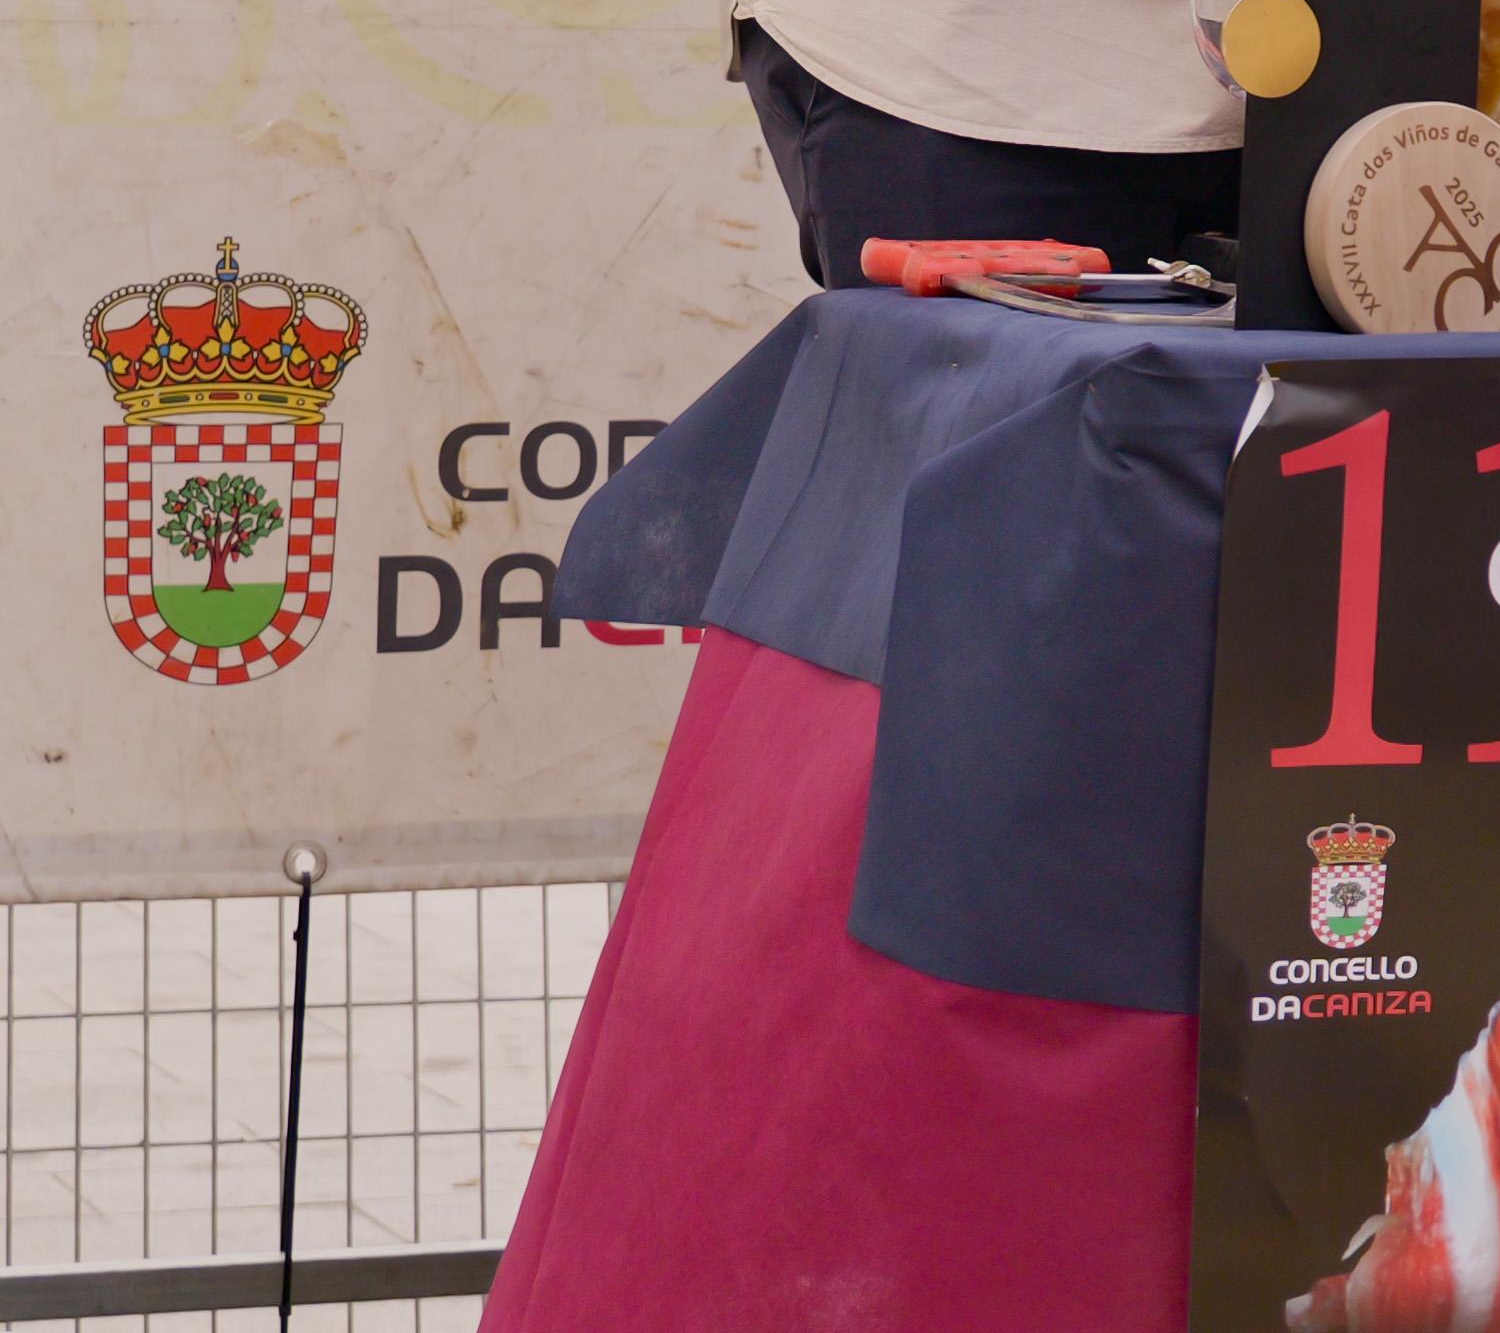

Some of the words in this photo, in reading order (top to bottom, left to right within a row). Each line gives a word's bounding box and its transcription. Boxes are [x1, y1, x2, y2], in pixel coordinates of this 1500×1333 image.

[1394, 125, 1450, 149] Viños
[1456, 126, 1479, 147] de
[1364, 147, 1393, 179] dos
[1342, 184, 1366, 236] Cata
[1445, 177, 1485, 228] 2025
[1342, 244, 1382, 317] XXXVII
[1270, 956, 1418, 984] CONCELLO
